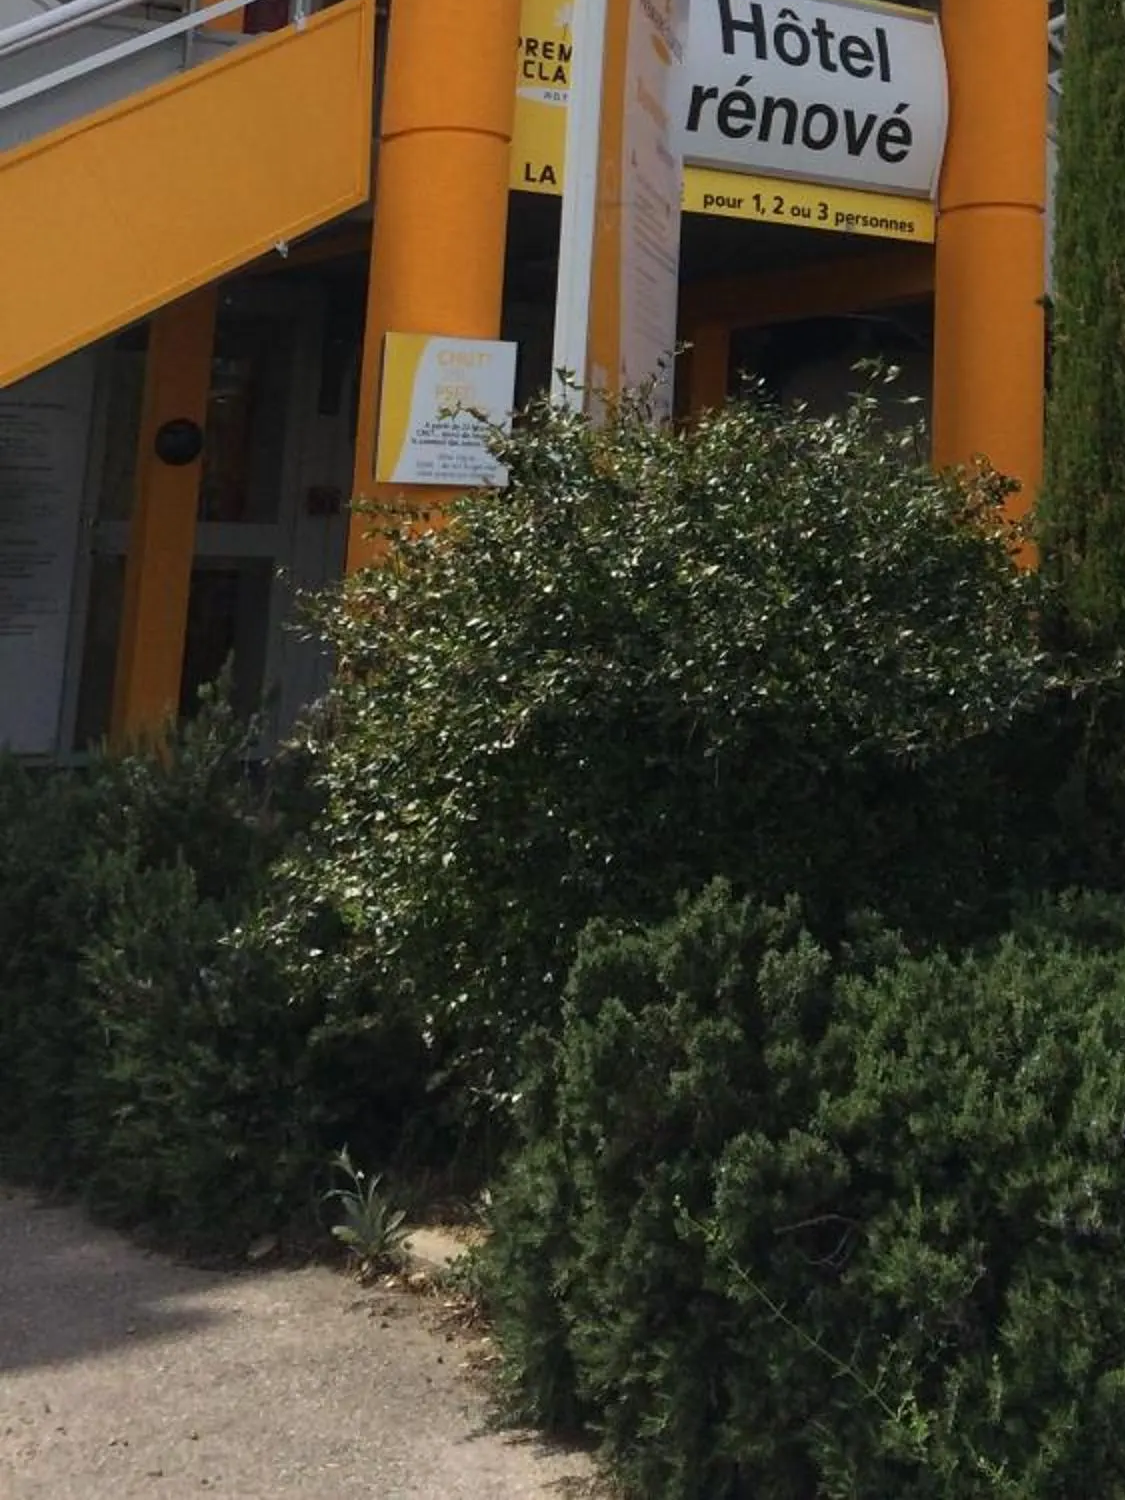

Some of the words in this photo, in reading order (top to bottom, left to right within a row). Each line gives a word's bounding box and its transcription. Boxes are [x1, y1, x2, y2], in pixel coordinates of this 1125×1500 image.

[686, 75, 912, 163] rénové
[525, 162, 557, 185] LA
[703, 194, 744, 209] pour
[752, 193, 766, 216] 1,
[772, 195, 785, 215] 2
[790, 205, 811, 219] ou
[817, 201, 829, 221] 3
[834, 211, 915, 233] personnes
